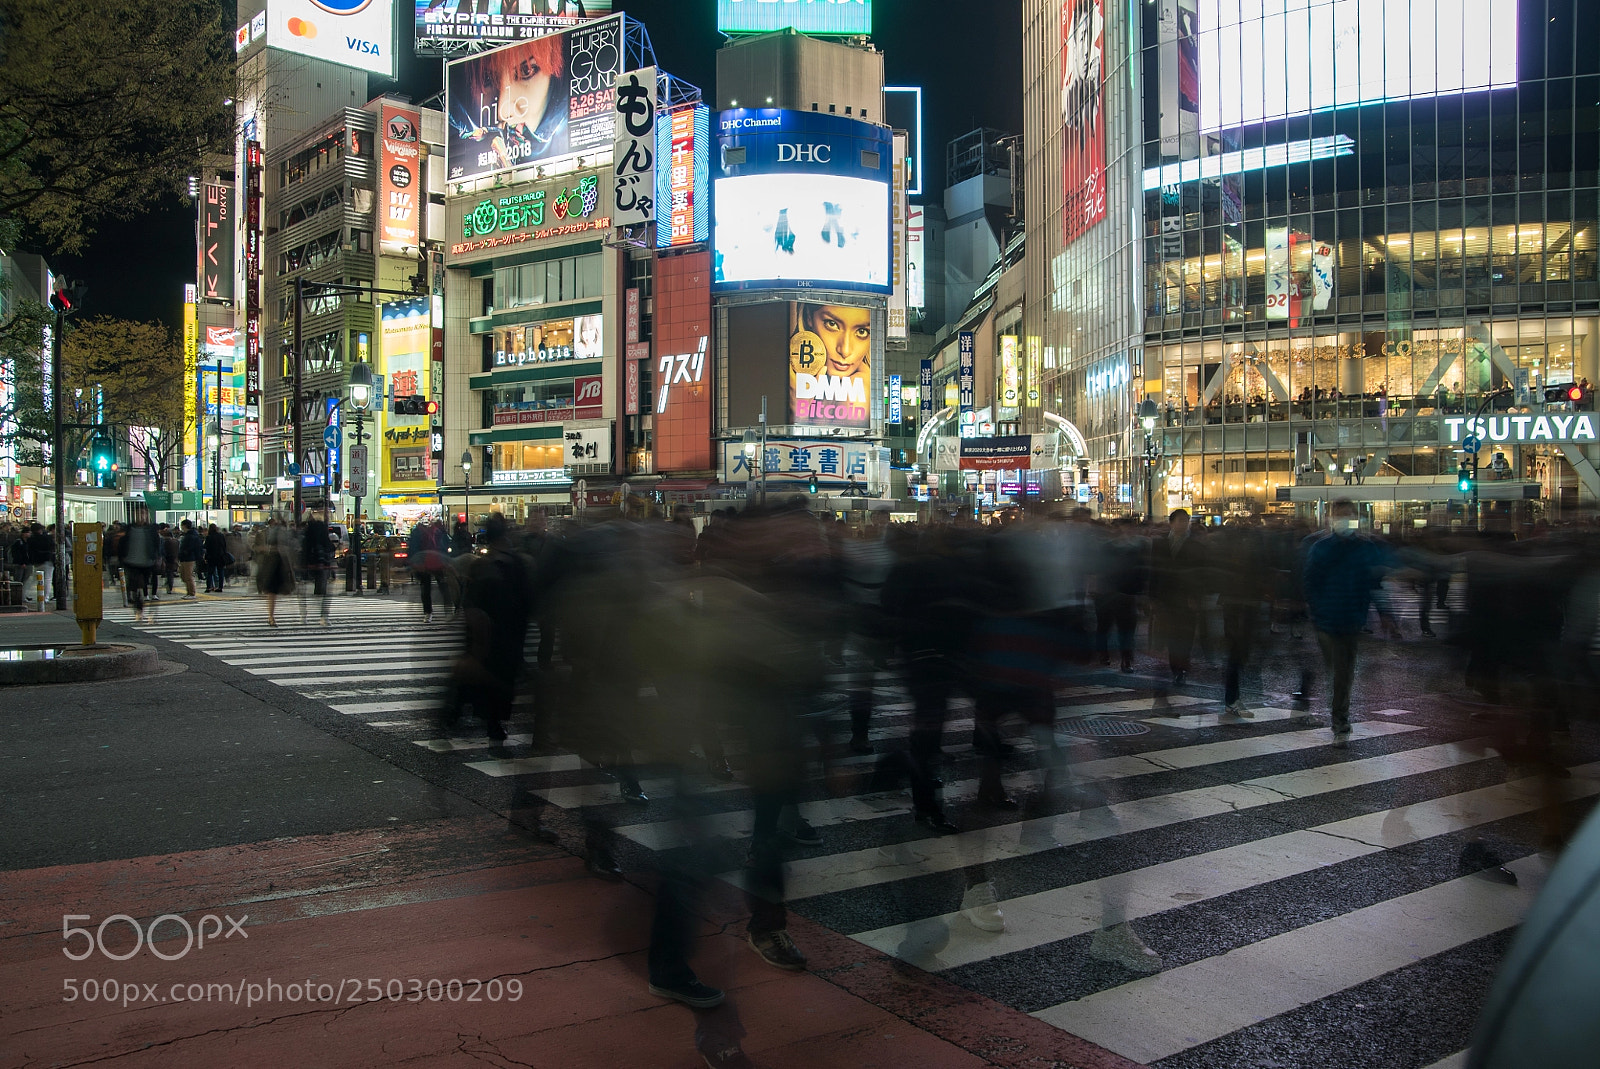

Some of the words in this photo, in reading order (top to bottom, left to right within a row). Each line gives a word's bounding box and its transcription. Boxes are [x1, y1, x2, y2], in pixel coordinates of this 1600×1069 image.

[426, 24, 455, 35] FIRST
[457, 25, 479, 36] FULL
[481, 26, 514, 37] ALBUM
[506, 16, 519, 24] THE
[346, 36, 380, 56] VISA
[570, 27, 619, 56] HURRY
[570, 43, 619, 80] GO
[570, 70, 618, 96] ROUND
[480, 86, 529, 127] hide
[570, 93, 594, 110] 5.26
[595, 88, 615, 104] SAT
[721, 119, 743, 130] DHC
[743, 117, 781, 129] Channel
[506, 140, 532, 160] 2018
[614, 76, 655, 218] もんじゃ
[777, 143, 831, 163] DHC
[672, 115, 689, 237] 三千里薬品
[1084, 172, 1099, 200] フジ
[219, 187, 227, 221] TOKYO
[499, 201, 545, 231] 西村
[1085, 187, 1105, 225] テレビ
[464, 214, 472, 238] 渋谷
[628, 291, 638, 340] お好み焼
[497, 344, 571, 366] Euphoria
[960, 335, 973, 406] 洋服の青山
[577, 380, 602, 402] JTB
[796, 373, 867, 402] DMM
[796, 400, 866, 420] Bitcoin
[1444, 415, 1596, 442] TSUTAYA
[571, 441, 598, 459] 松川
[732, 447, 866, 475] 大盛堂書店
[351, 450, 360, 492] 道玄坂
